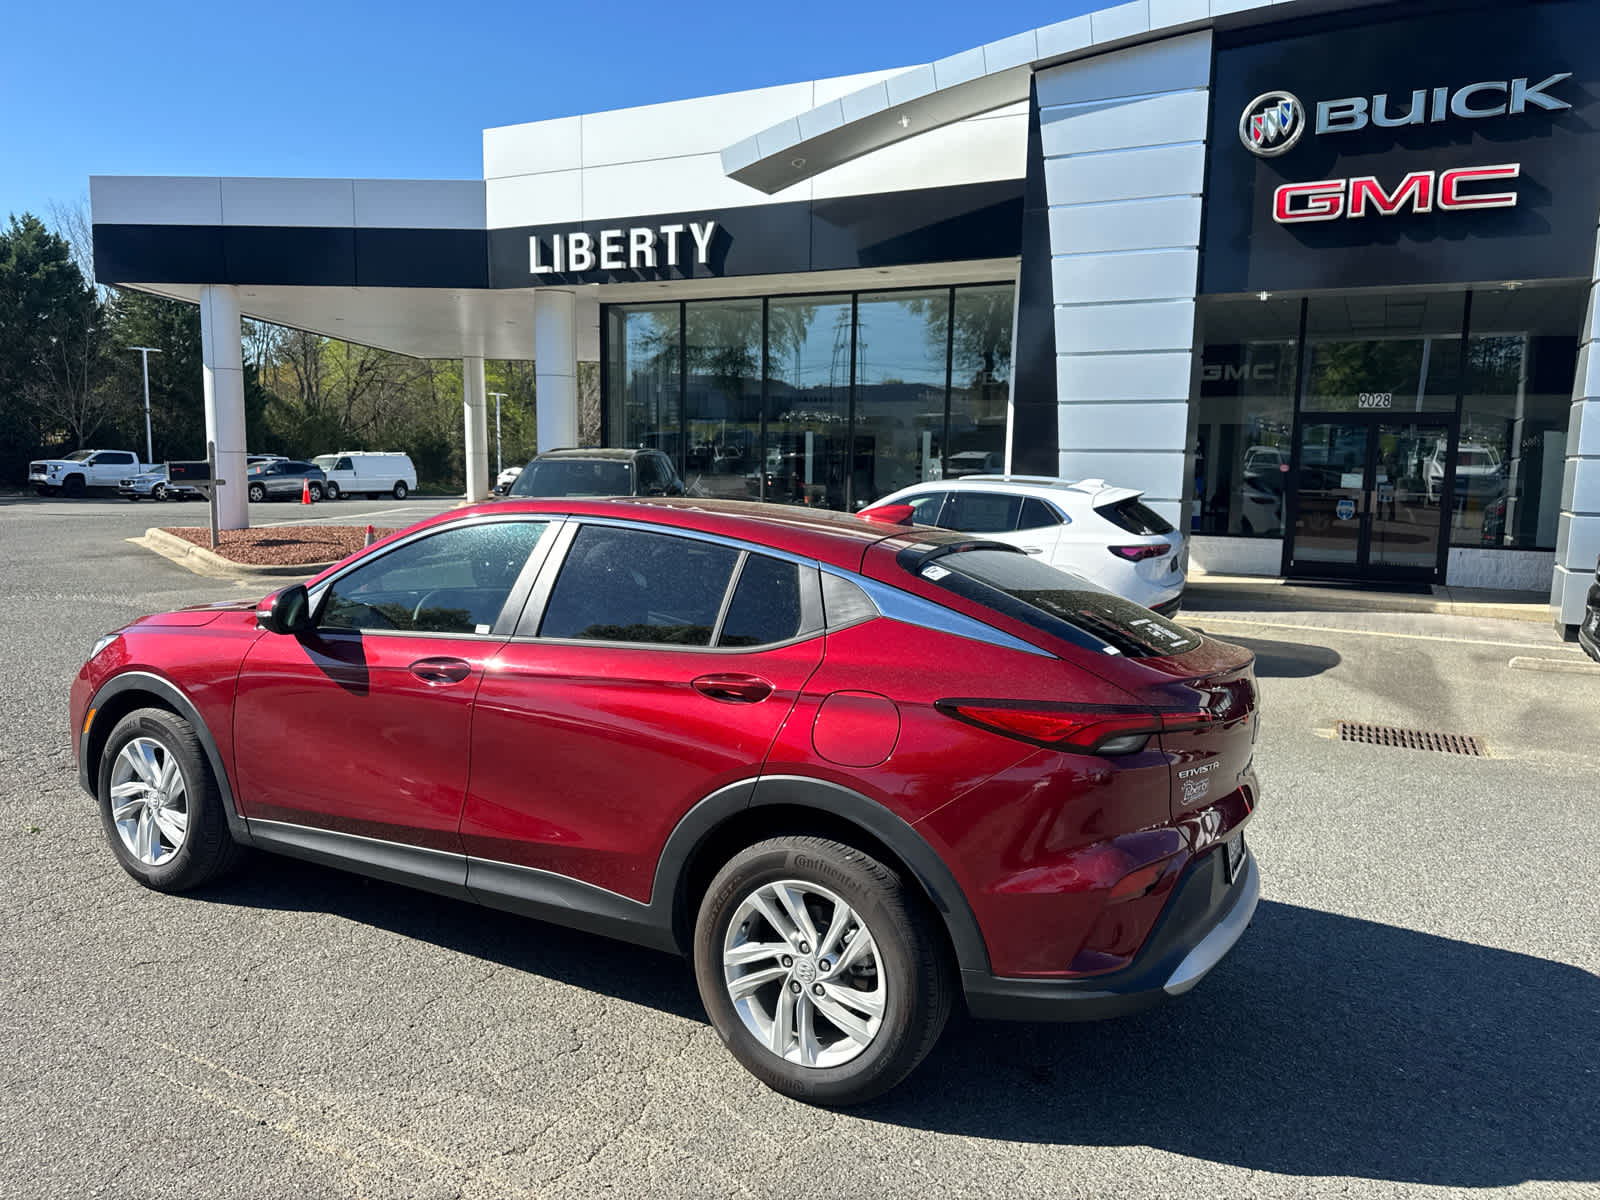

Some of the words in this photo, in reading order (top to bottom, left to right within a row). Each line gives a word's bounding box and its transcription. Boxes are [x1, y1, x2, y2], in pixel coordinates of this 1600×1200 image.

[1314, 72, 1573, 136] BUICK
[1272, 163, 1521, 224] GMC
[528, 221, 716, 275] LIBERTY
[1359, 393, 1392, 408] 9028
